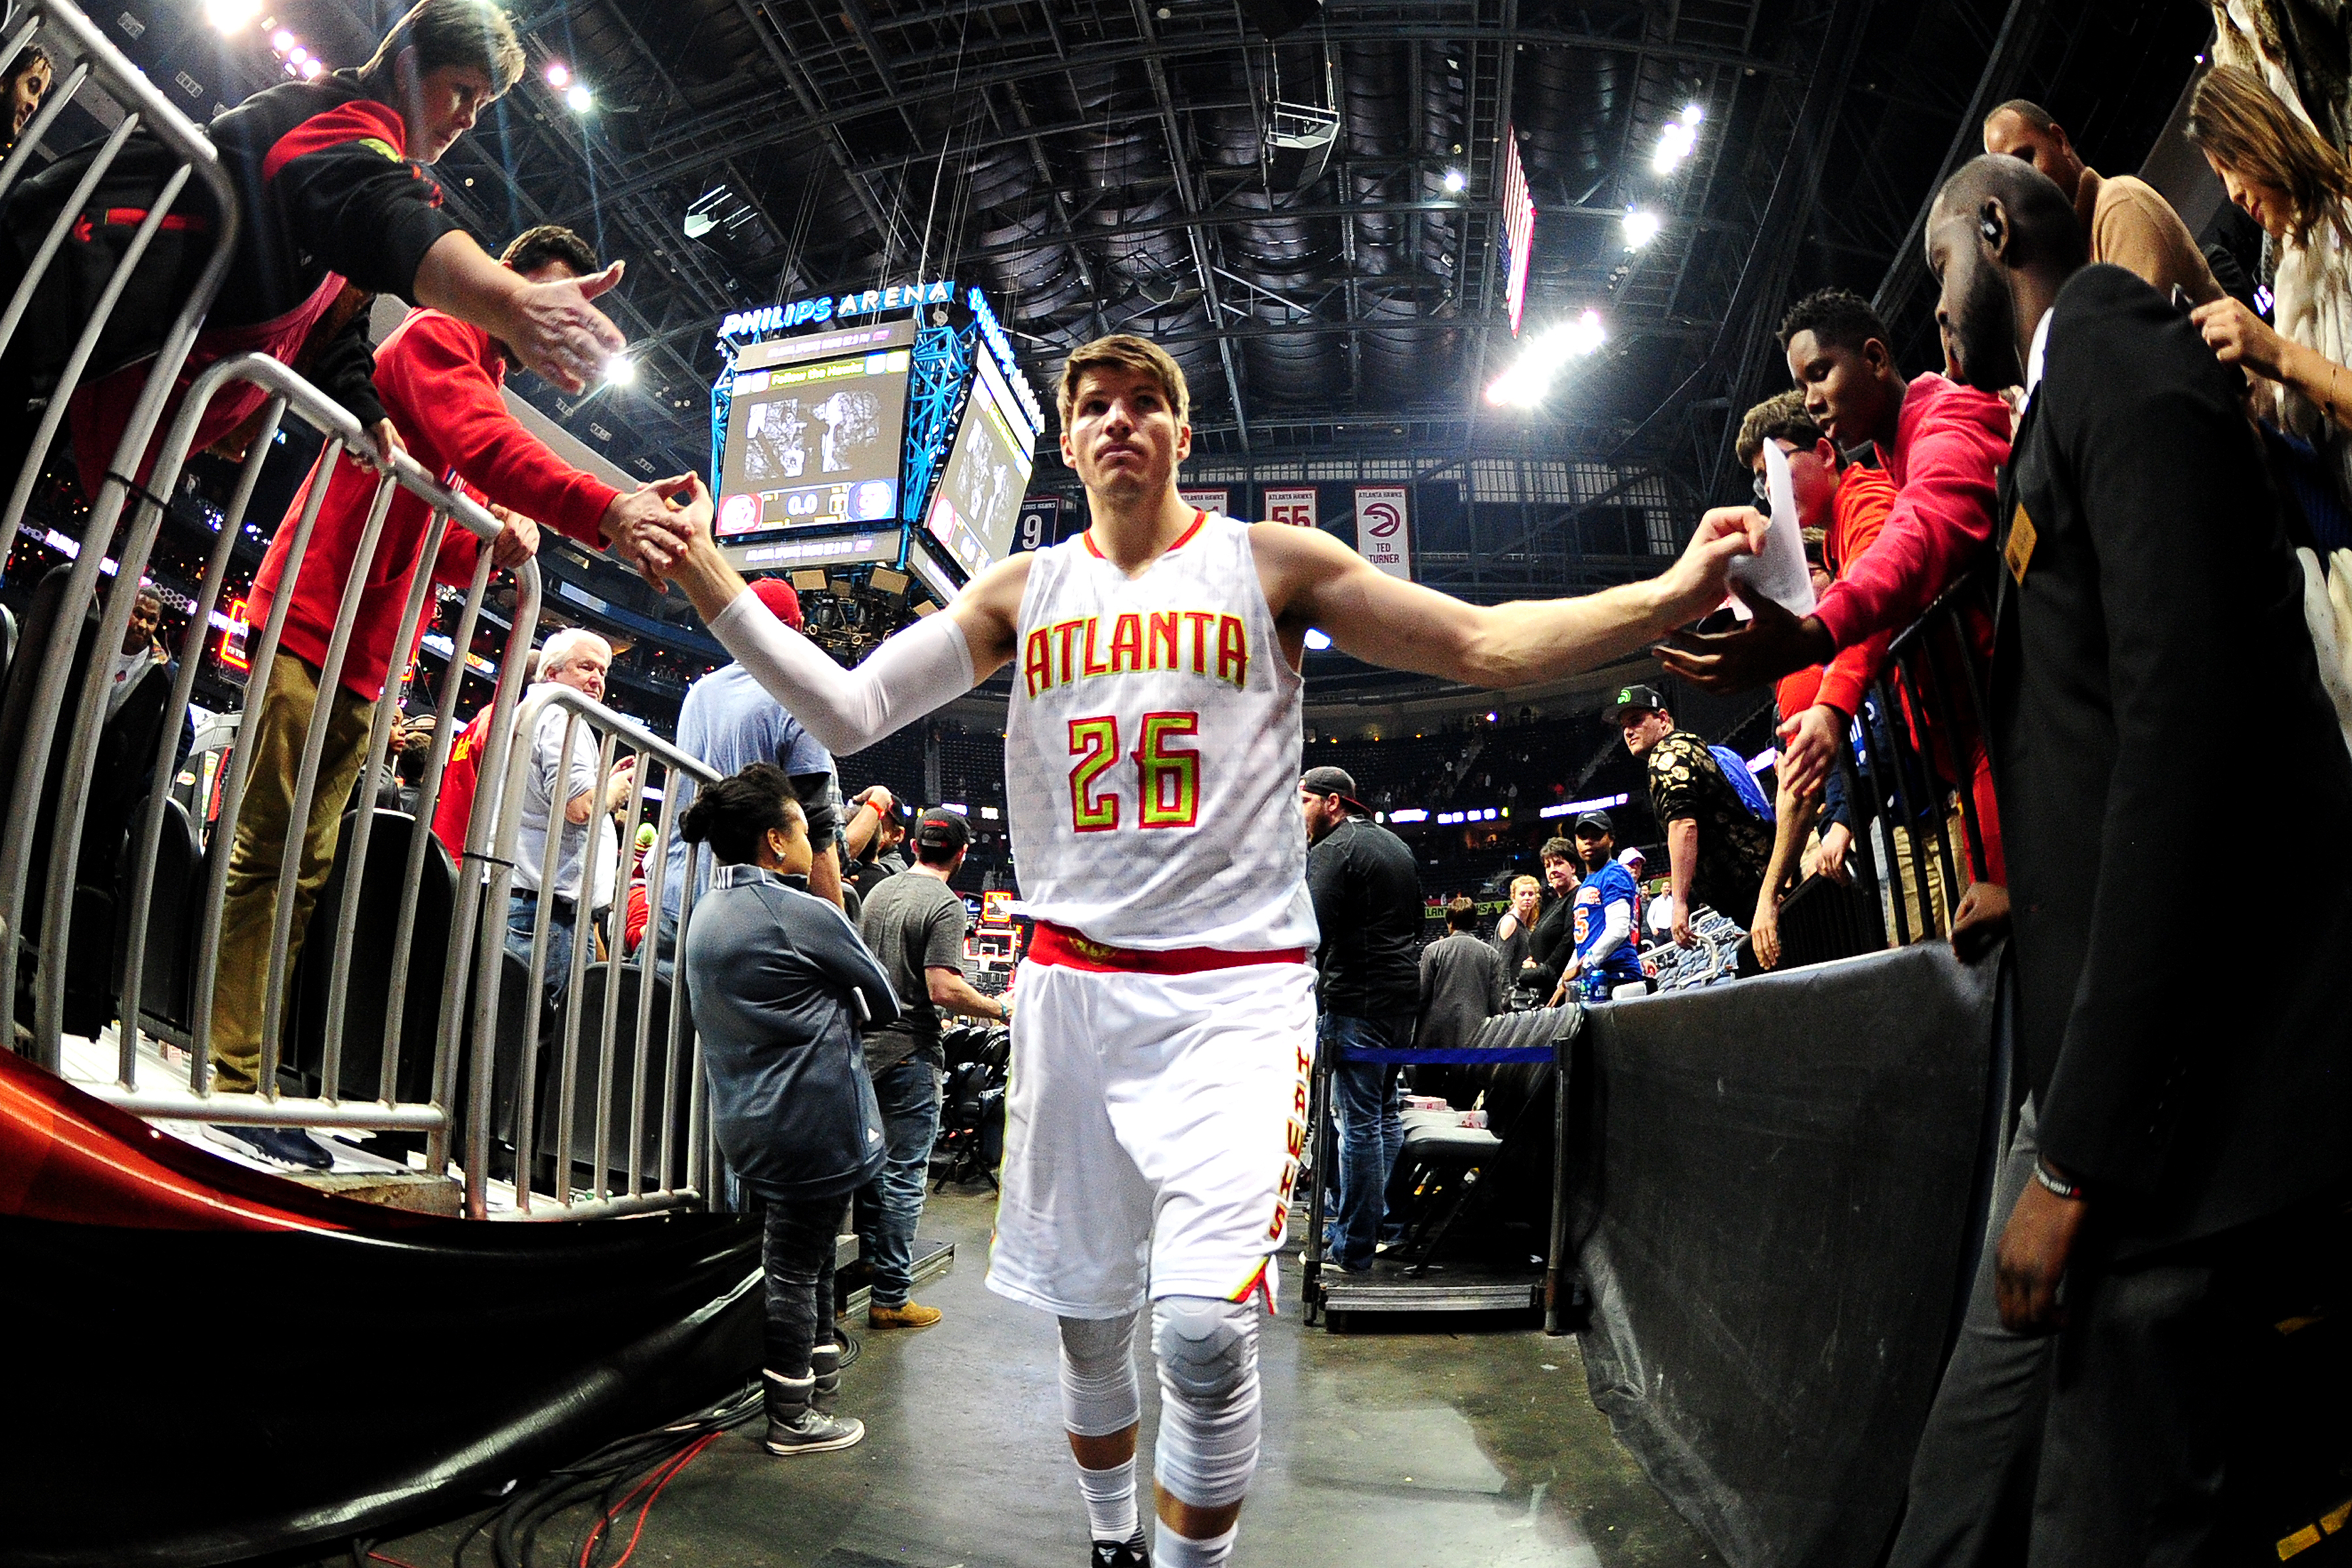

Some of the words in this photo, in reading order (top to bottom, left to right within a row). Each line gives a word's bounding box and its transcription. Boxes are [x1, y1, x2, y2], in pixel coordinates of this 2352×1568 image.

[719, 297, 833, 337] PHILIPS
[838, 280, 949, 315] ARENA
[808, 367, 826, 380] the
[1022, 515, 1042, 549] 9
[1272, 506, 1311, 527] 55
[1369, 554, 1399, 563] TURNER
[1376, 543, 1391, 552] TED
[1024, 612, 1248, 699] ATLANTA
[1069, 711, 1200, 833] 26
[1269, 1045, 1311, 1242] HAWKS
